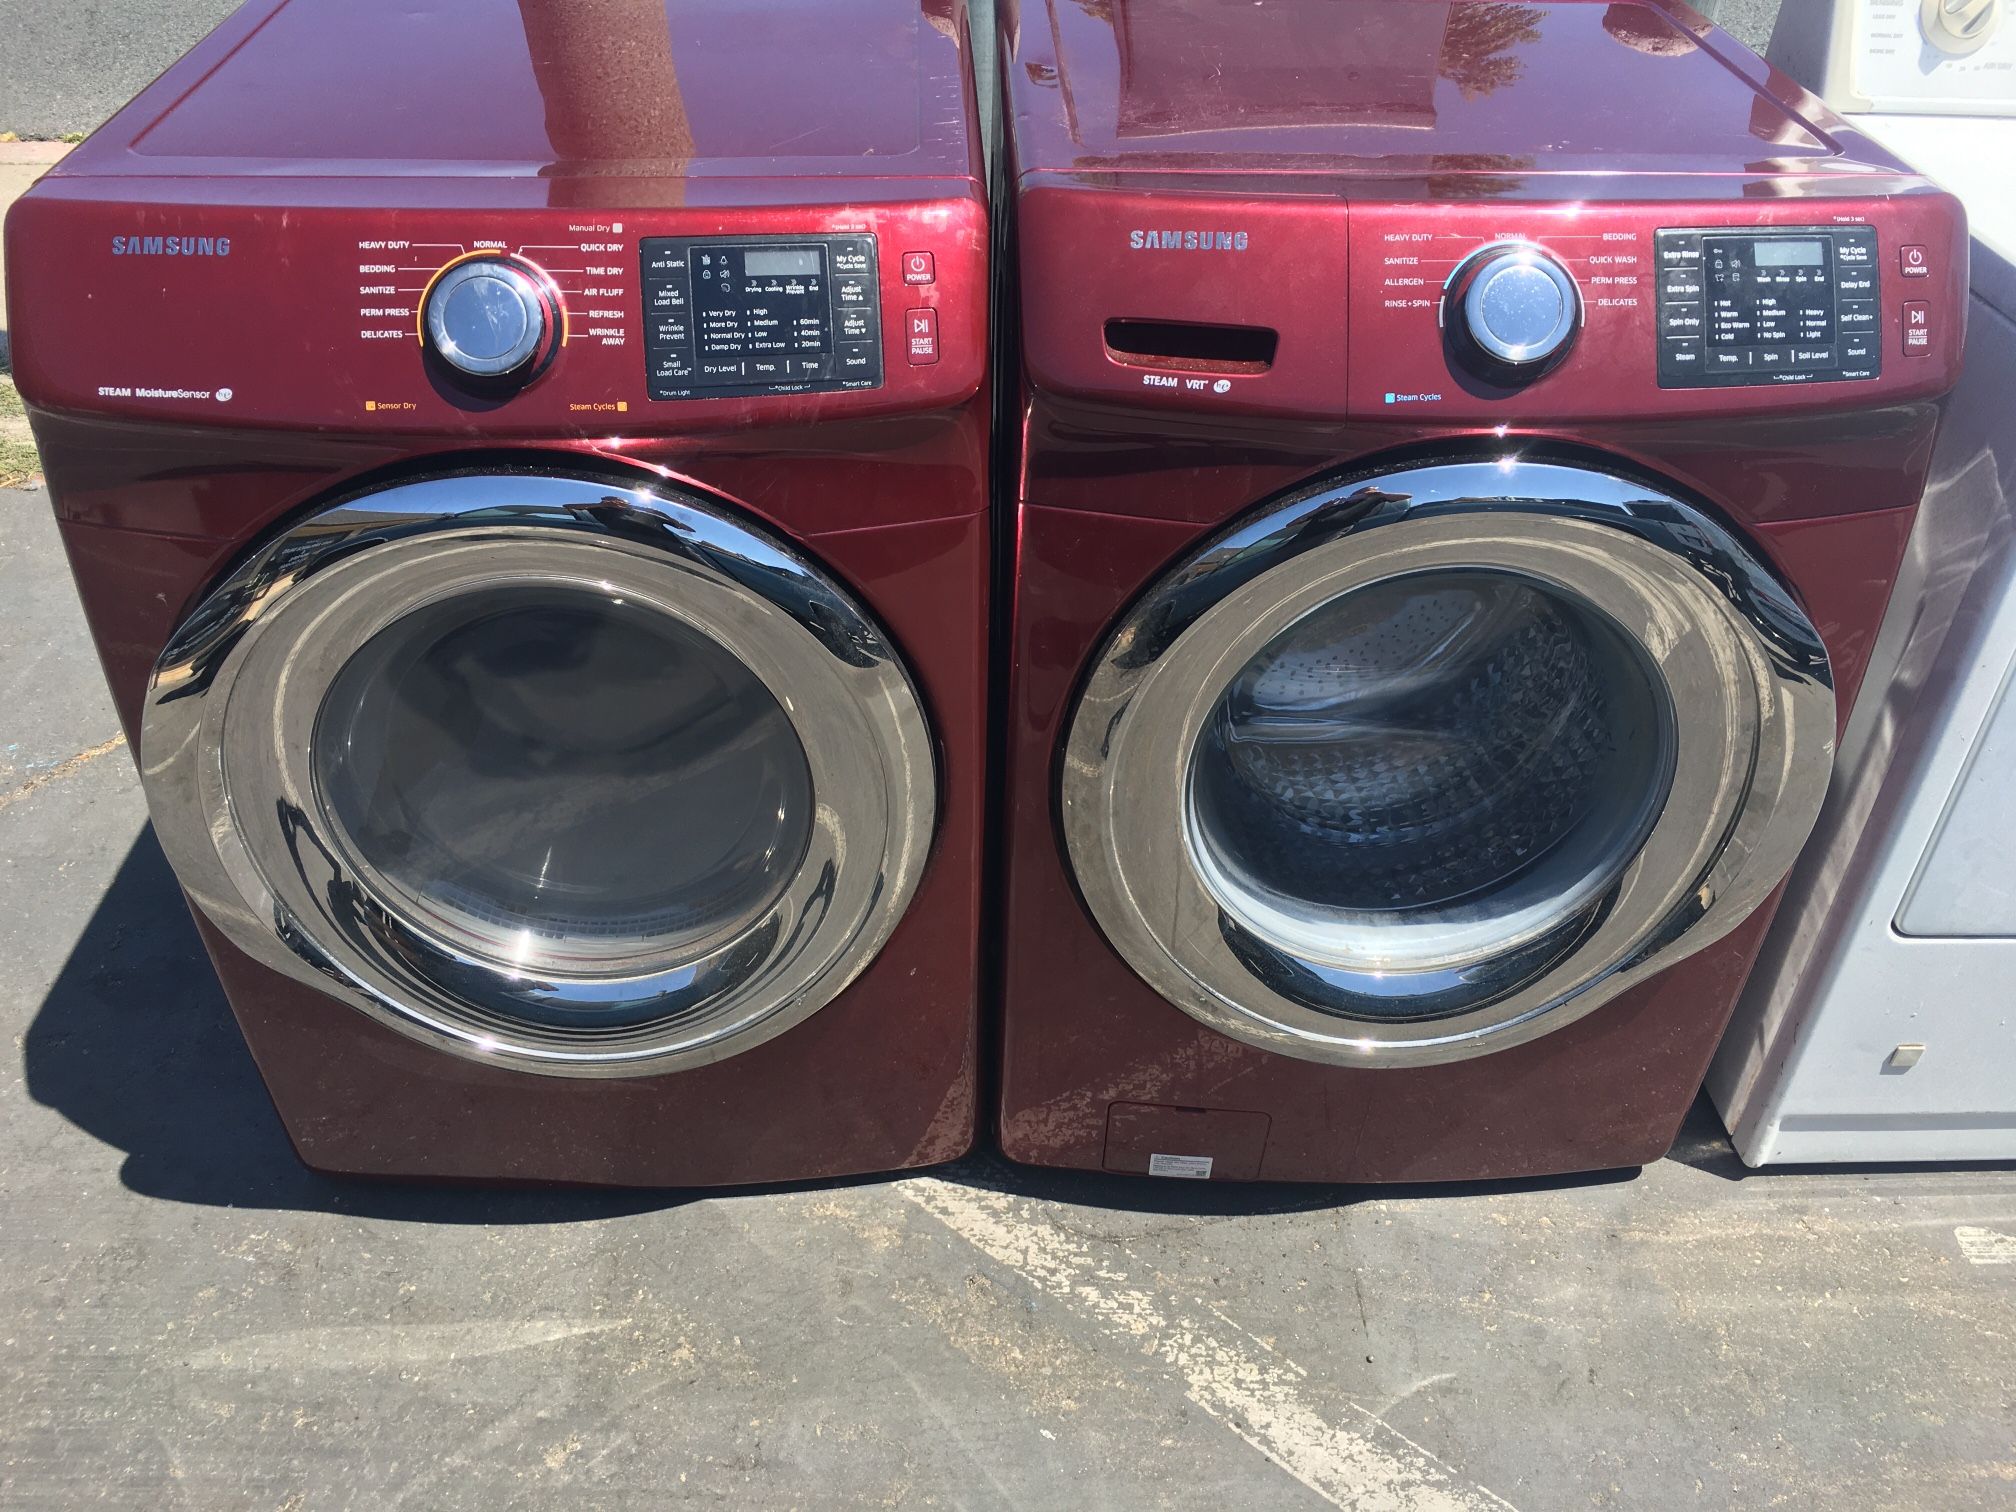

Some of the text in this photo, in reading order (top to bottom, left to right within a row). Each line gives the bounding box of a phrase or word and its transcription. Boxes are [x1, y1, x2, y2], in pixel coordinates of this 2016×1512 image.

[569, 224, 610, 233] Manual Dry
[1130, 230, 1248, 250] SAMSUNG
[112, 236, 230, 256] SAMSUNG
[359, 241, 385, 249] HEAVY
[581, 244, 605, 252] QUICK
[1384, 257, 1418, 265] SANITIZE
[1590, 256, 1613, 264] QUICK
[359, 265, 396, 273] BEDDING
[586, 267, 624, 275] TIME DRY
[1384, 278, 1424, 286] ALLERGEN
[1841, 281, 1858, 289] Delay
[360, 286, 395, 294] SANITIZE
[1686, 285, 1699, 293] Spin
[1598, 298, 1637, 306] DELICATES
[361, 308, 409, 316] PERM PRESS
[589, 310, 624, 318] REFRESH
[1685, 318, 1699, 326] Only
[361, 330, 403, 338] DELICATES
[589, 328, 624, 336] WRINKLE
[602, 337, 625, 345] AWAY
[1719, 354, 1738, 362] Temp.
[705, 365, 717, 373] Dry
[1143, 375, 1178, 387] STEAM
[98, 387, 131, 396] STEAM
[136, 388, 210, 399] MoistureSensor
[1397, 393, 1441, 402] Steam Cycles
[404, 402, 416, 411] Dry
[594, 403, 615, 412] Cycles
